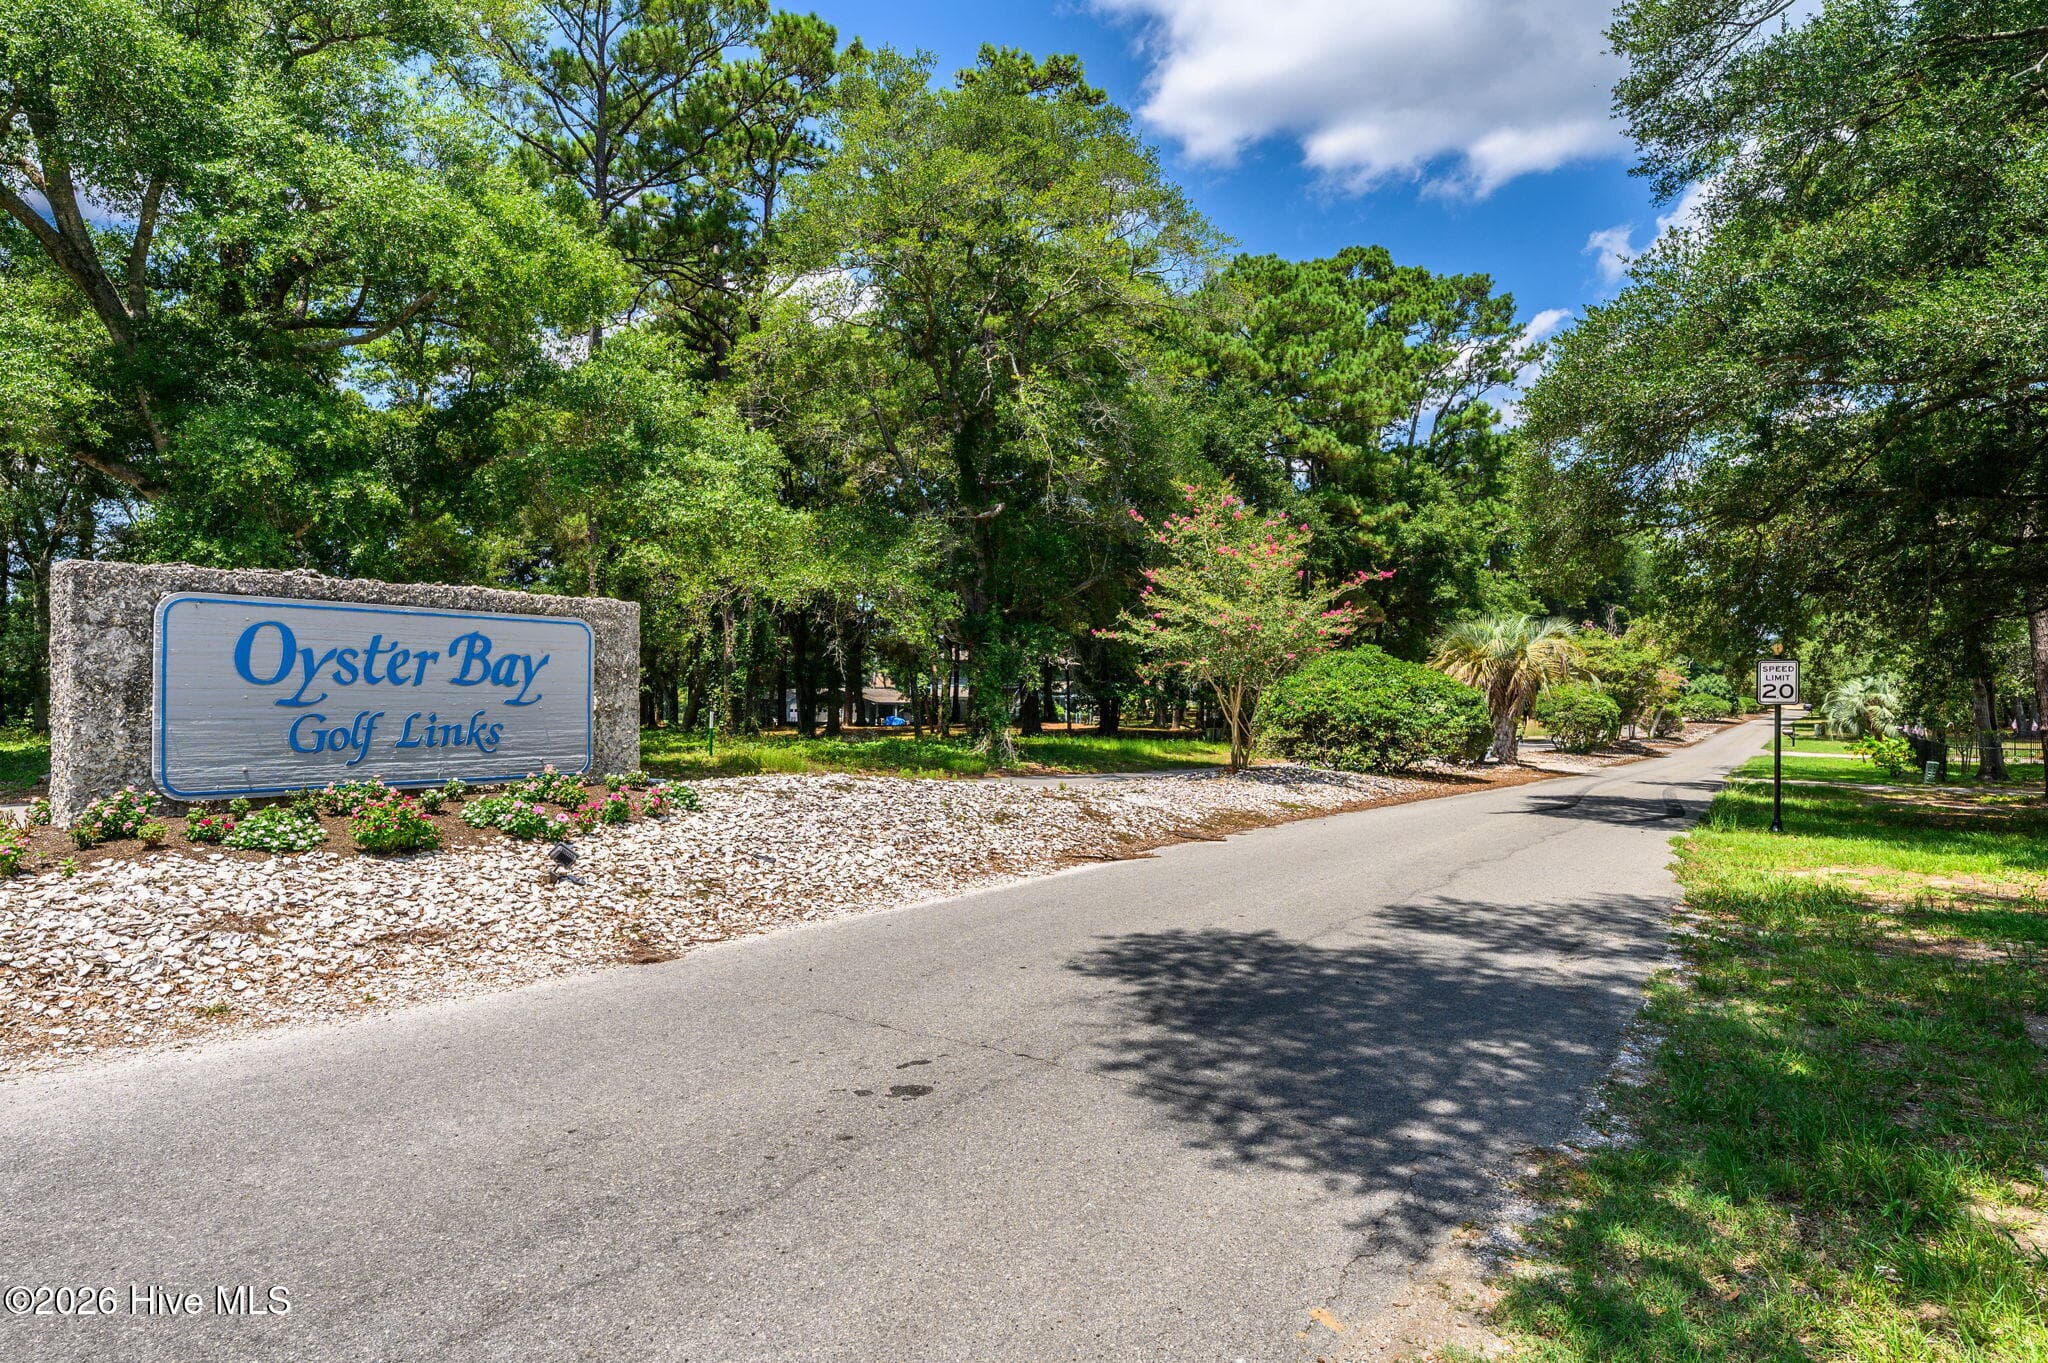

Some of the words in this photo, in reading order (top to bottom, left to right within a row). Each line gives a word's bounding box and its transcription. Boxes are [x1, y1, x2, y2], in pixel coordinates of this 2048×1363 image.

[233, 620, 440, 707] Oyster
[448, 629, 551, 706] Bay
[1762, 684, 1794, 699] 20
[288, 710, 385, 766] Golf
[395, 709, 504, 753] Links
